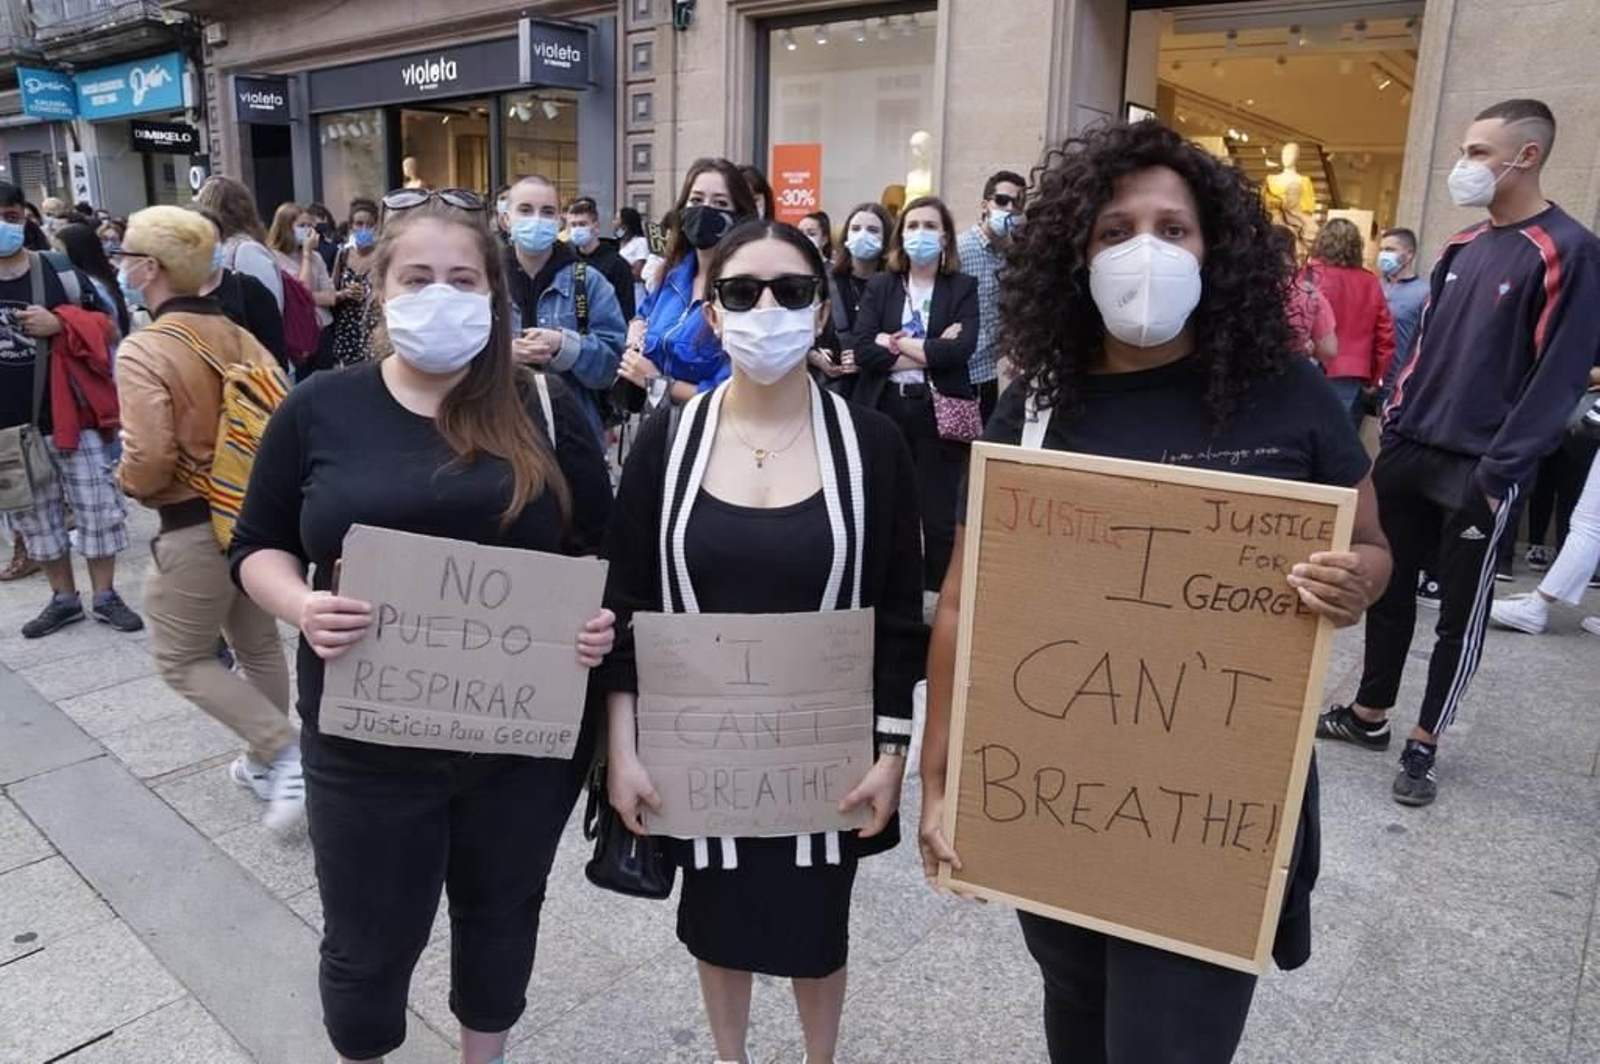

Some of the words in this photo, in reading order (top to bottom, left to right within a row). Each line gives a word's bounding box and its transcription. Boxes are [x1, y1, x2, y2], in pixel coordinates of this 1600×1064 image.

[401, 56, 457, 86] violeta
[533, 42, 581, 62] violeta
[239, 91, 284, 106] violeta
[776, 188, 816, 207] -30%
[1203, 498, 1335, 542] JUSTICE
[440, 555, 513, 610] NO
[1106, 525, 1191, 609] I
[1238, 545, 1288, 576] FOR
[376, 603, 533, 656] PUEDO
[724, 638, 771, 687] I
[1013, 639, 1273, 733] CAN'T
[352, 659, 537, 720] RESPIRAR
[337, 705, 442, 738] Justicia
[493, 724, 572, 753] George
[974, 744, 1278, 853] BREATHE!
